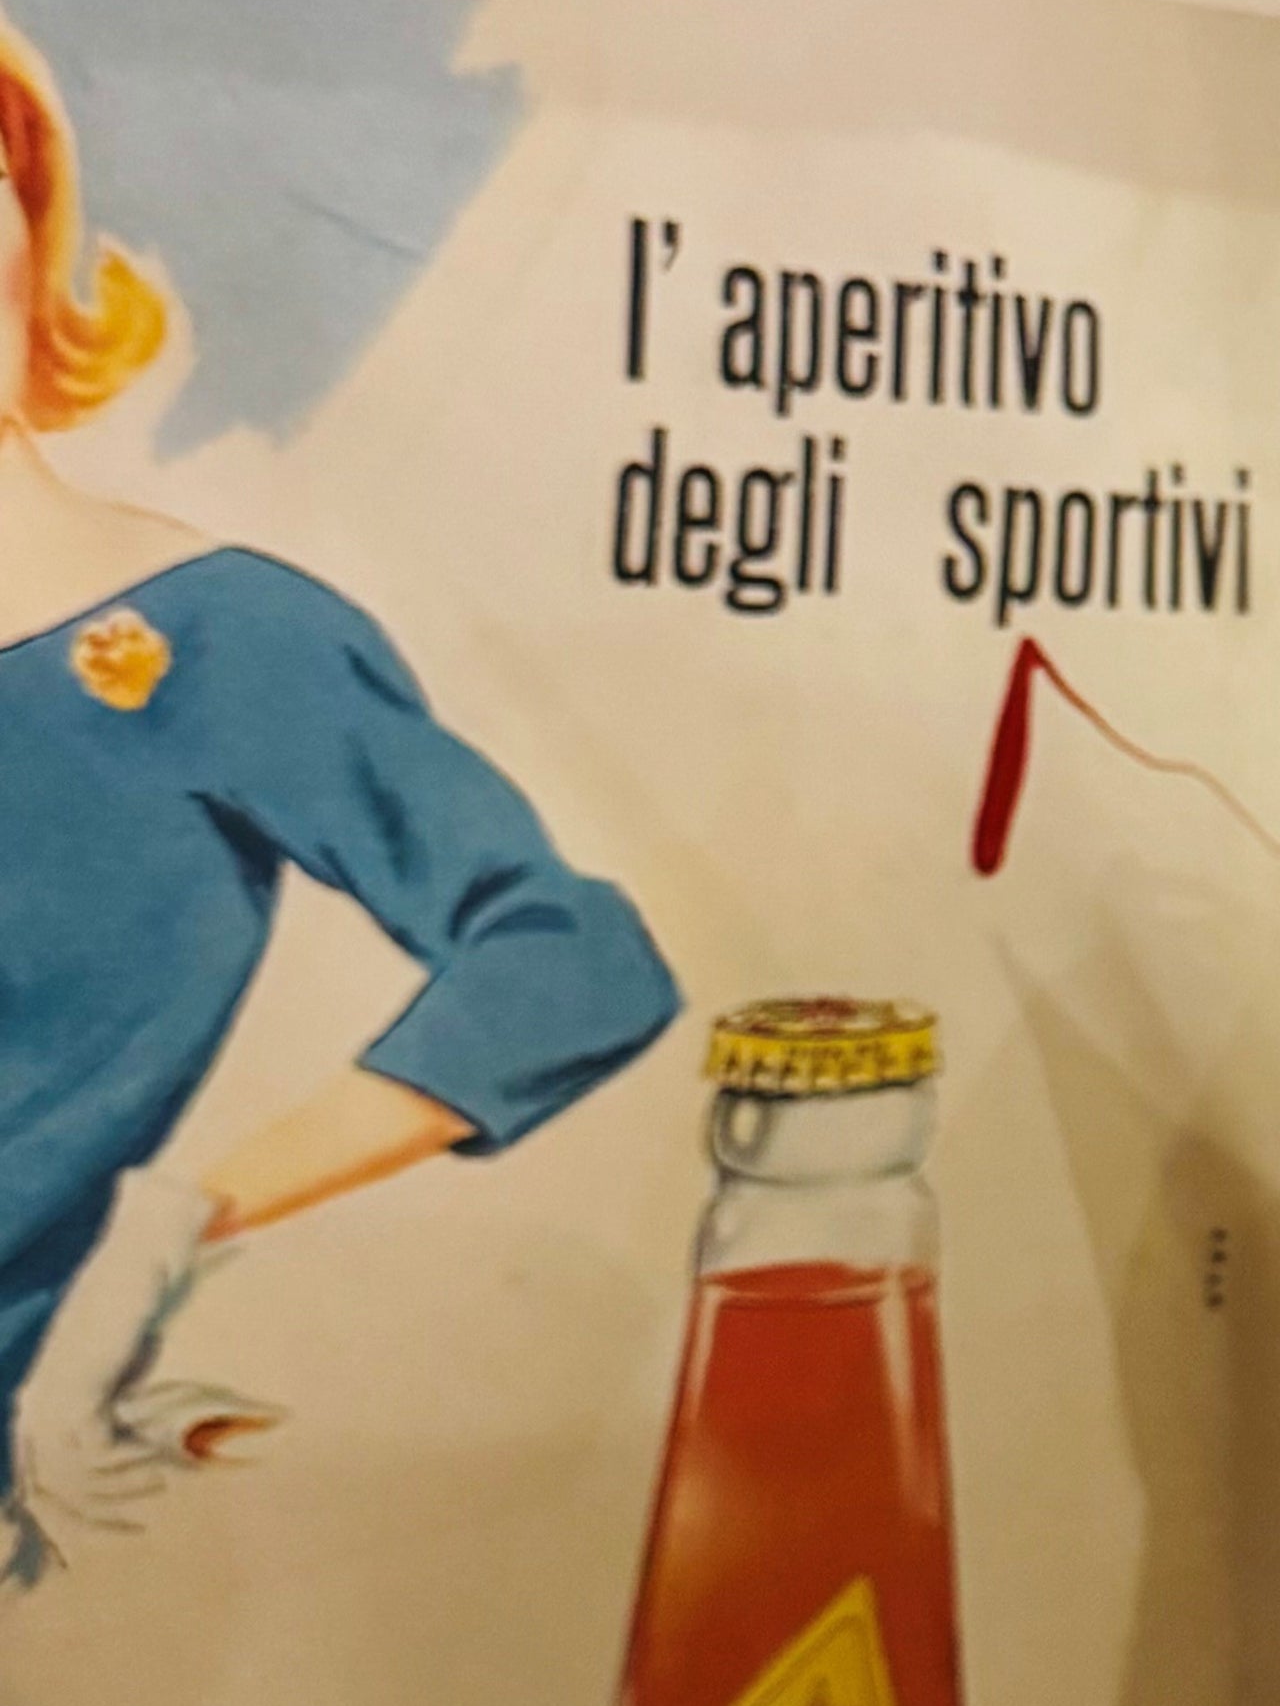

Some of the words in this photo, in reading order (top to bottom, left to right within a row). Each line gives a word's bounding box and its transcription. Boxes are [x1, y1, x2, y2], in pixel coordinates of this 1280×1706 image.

[717, 248, 1103, 420] aperitivo
[611, 424, 849, 617] degli
[940, 462, 1254, 630] sportivi
